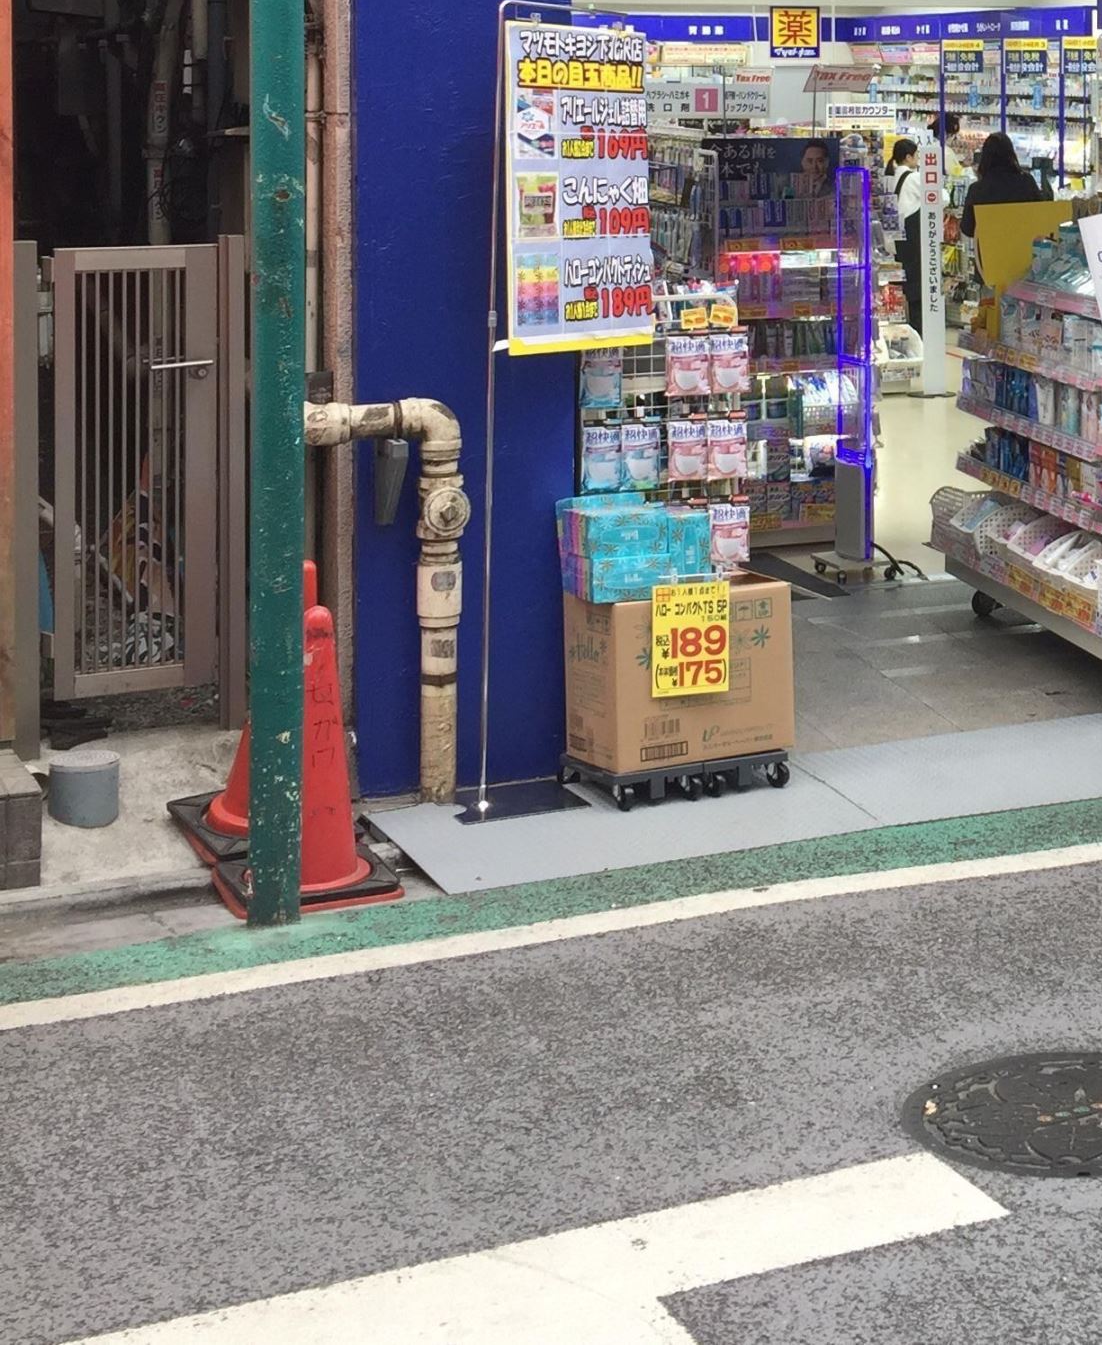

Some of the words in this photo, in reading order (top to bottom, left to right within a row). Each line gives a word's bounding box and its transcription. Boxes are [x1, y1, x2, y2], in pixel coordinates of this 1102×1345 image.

[778, 10, 812, 45] 薬
[519, 30, 643, 63] マツモトキヨシ下北沢店
[597, 127, 648, 160] 169円
[925, 153, 937, 184] 出口
[562, 176, 649, 206] こんにゃく畑
[599, 206, 650, 238] 109円
[601, 284, 653, 318] 189円
[670, 624, 726, 659] 189
